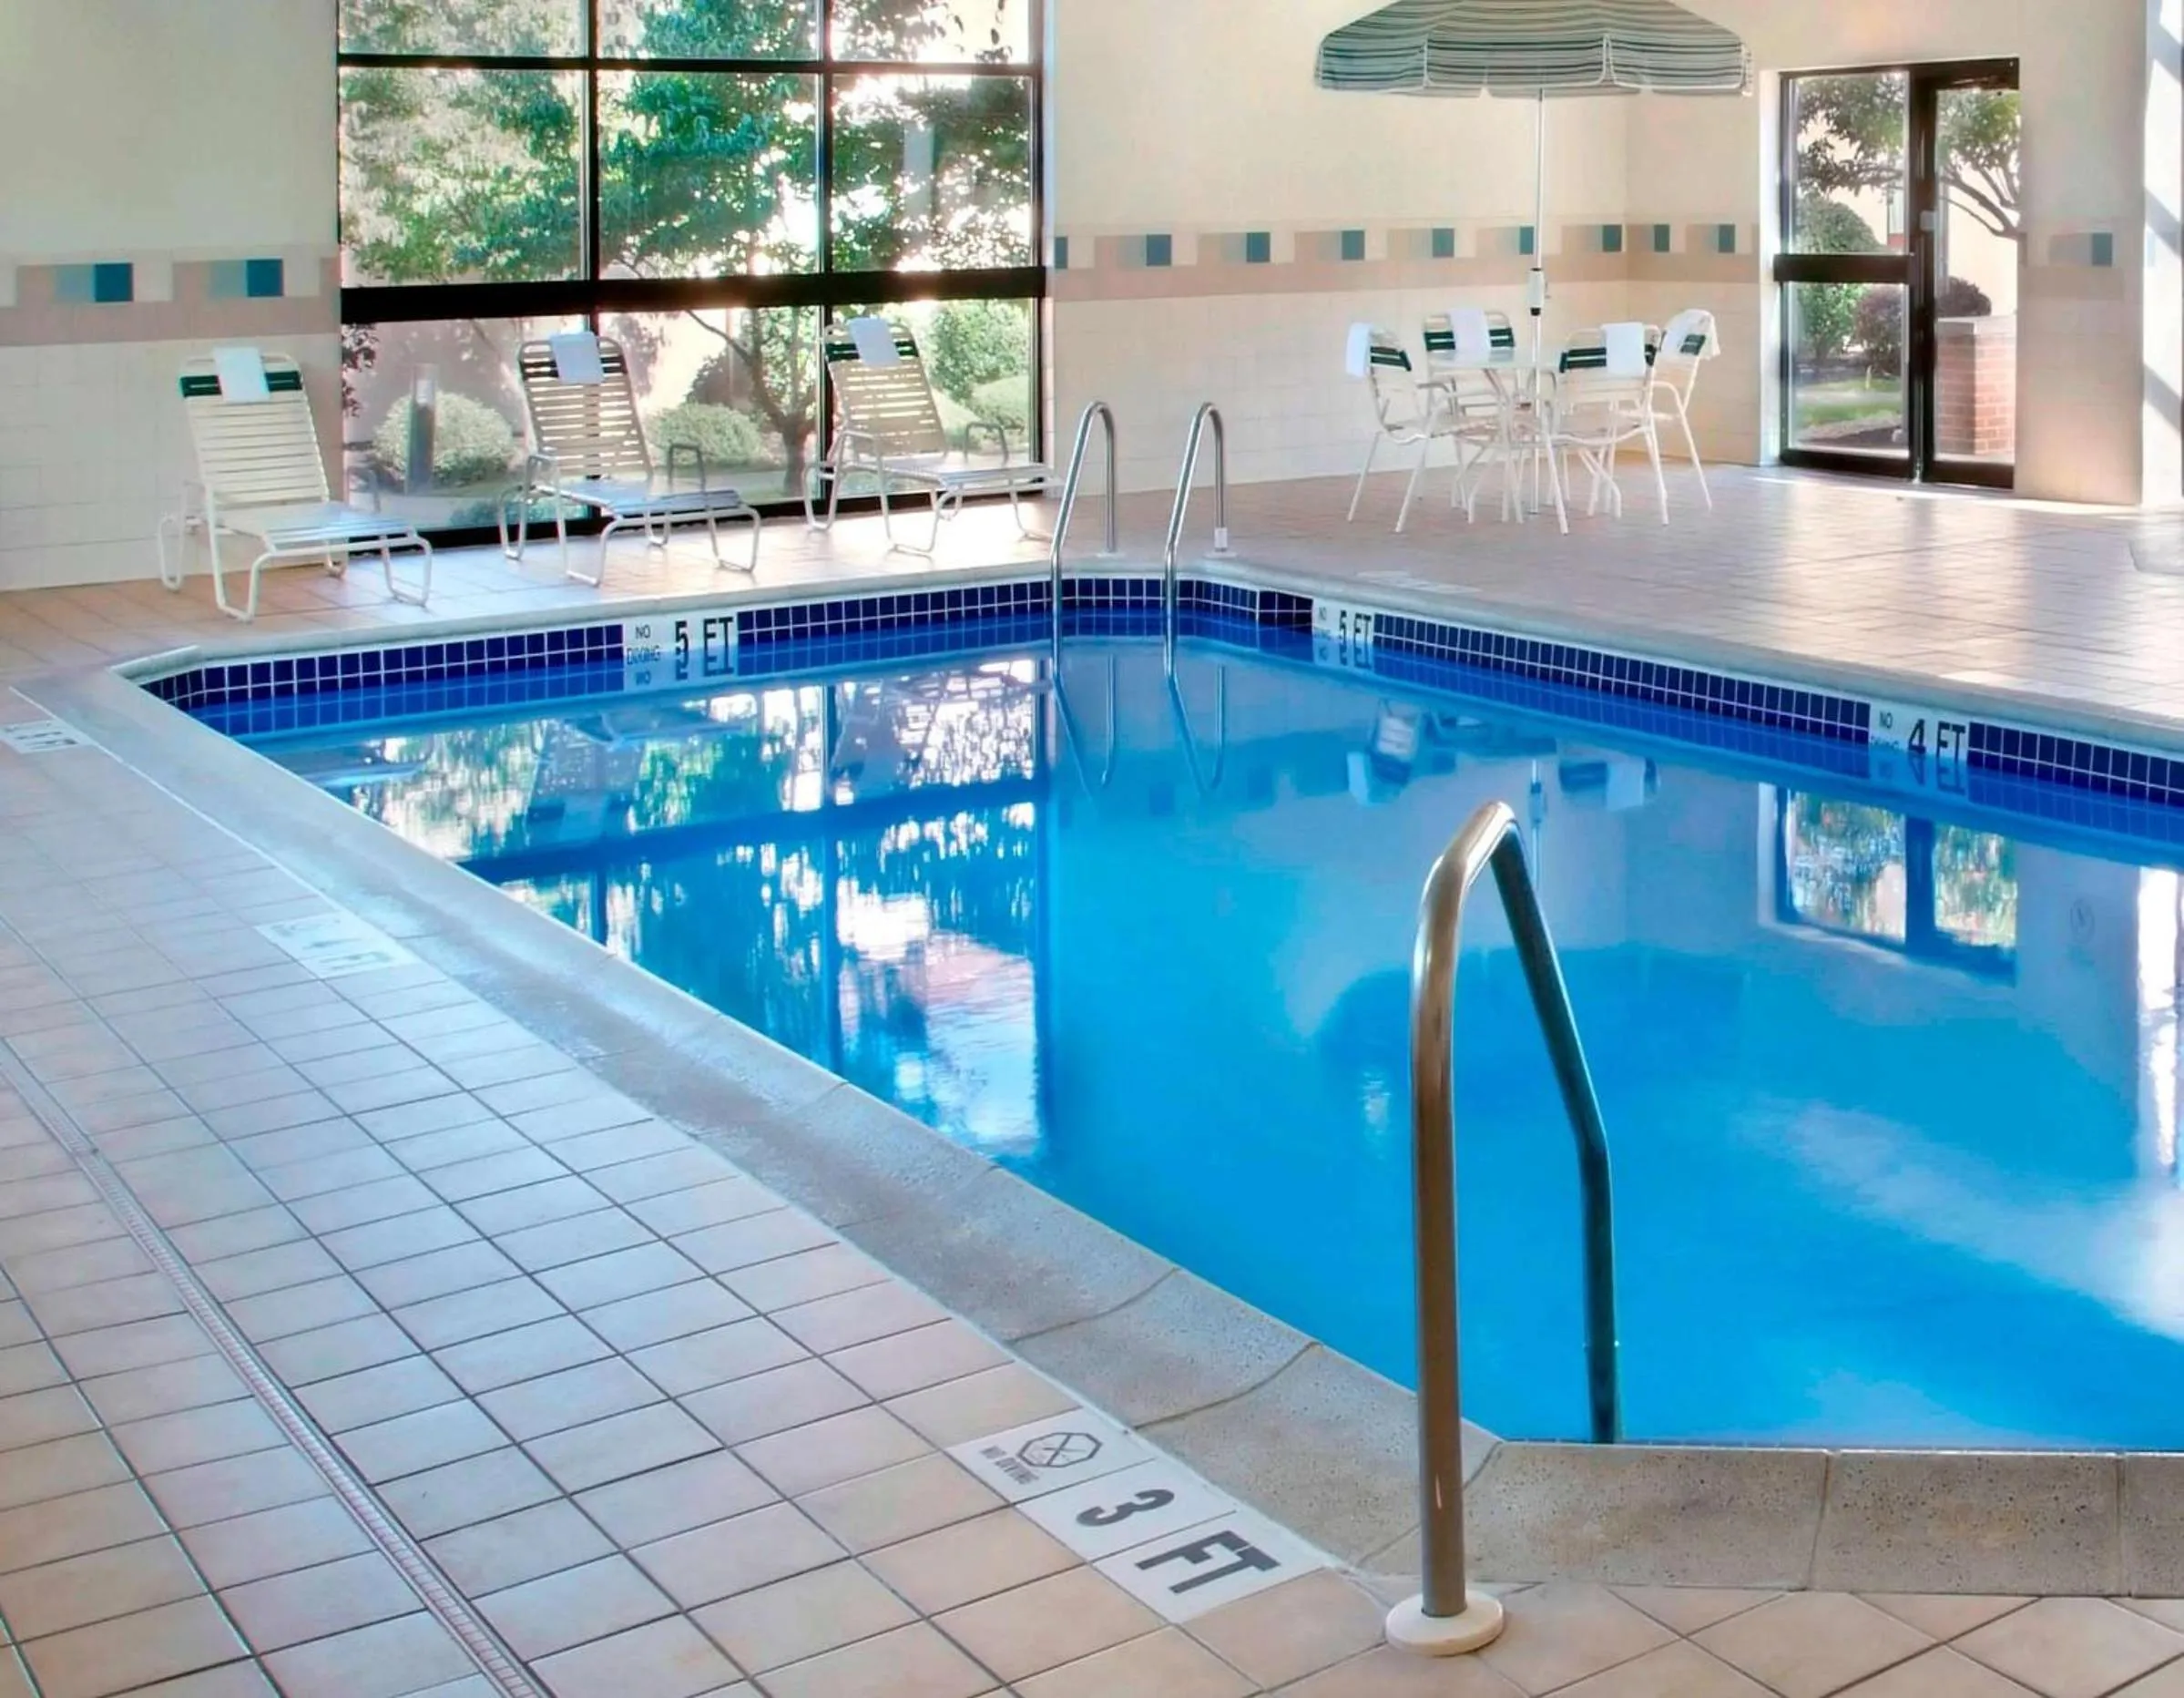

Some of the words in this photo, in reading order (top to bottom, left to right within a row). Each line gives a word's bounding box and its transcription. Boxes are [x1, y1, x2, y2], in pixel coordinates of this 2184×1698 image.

[635, 624, 651, 639] NO
[674, 620, 689, 654] 5
[702, 616, 734, 650] FT
[1353, 611, 1372, 643] FT
[1908, 718, 1926, 754] 4
[1936, 720, 1966, 759] FT
[1076, 1488, 1175, 1527] 3
[1134, 1529, 1281, 1594] FT
